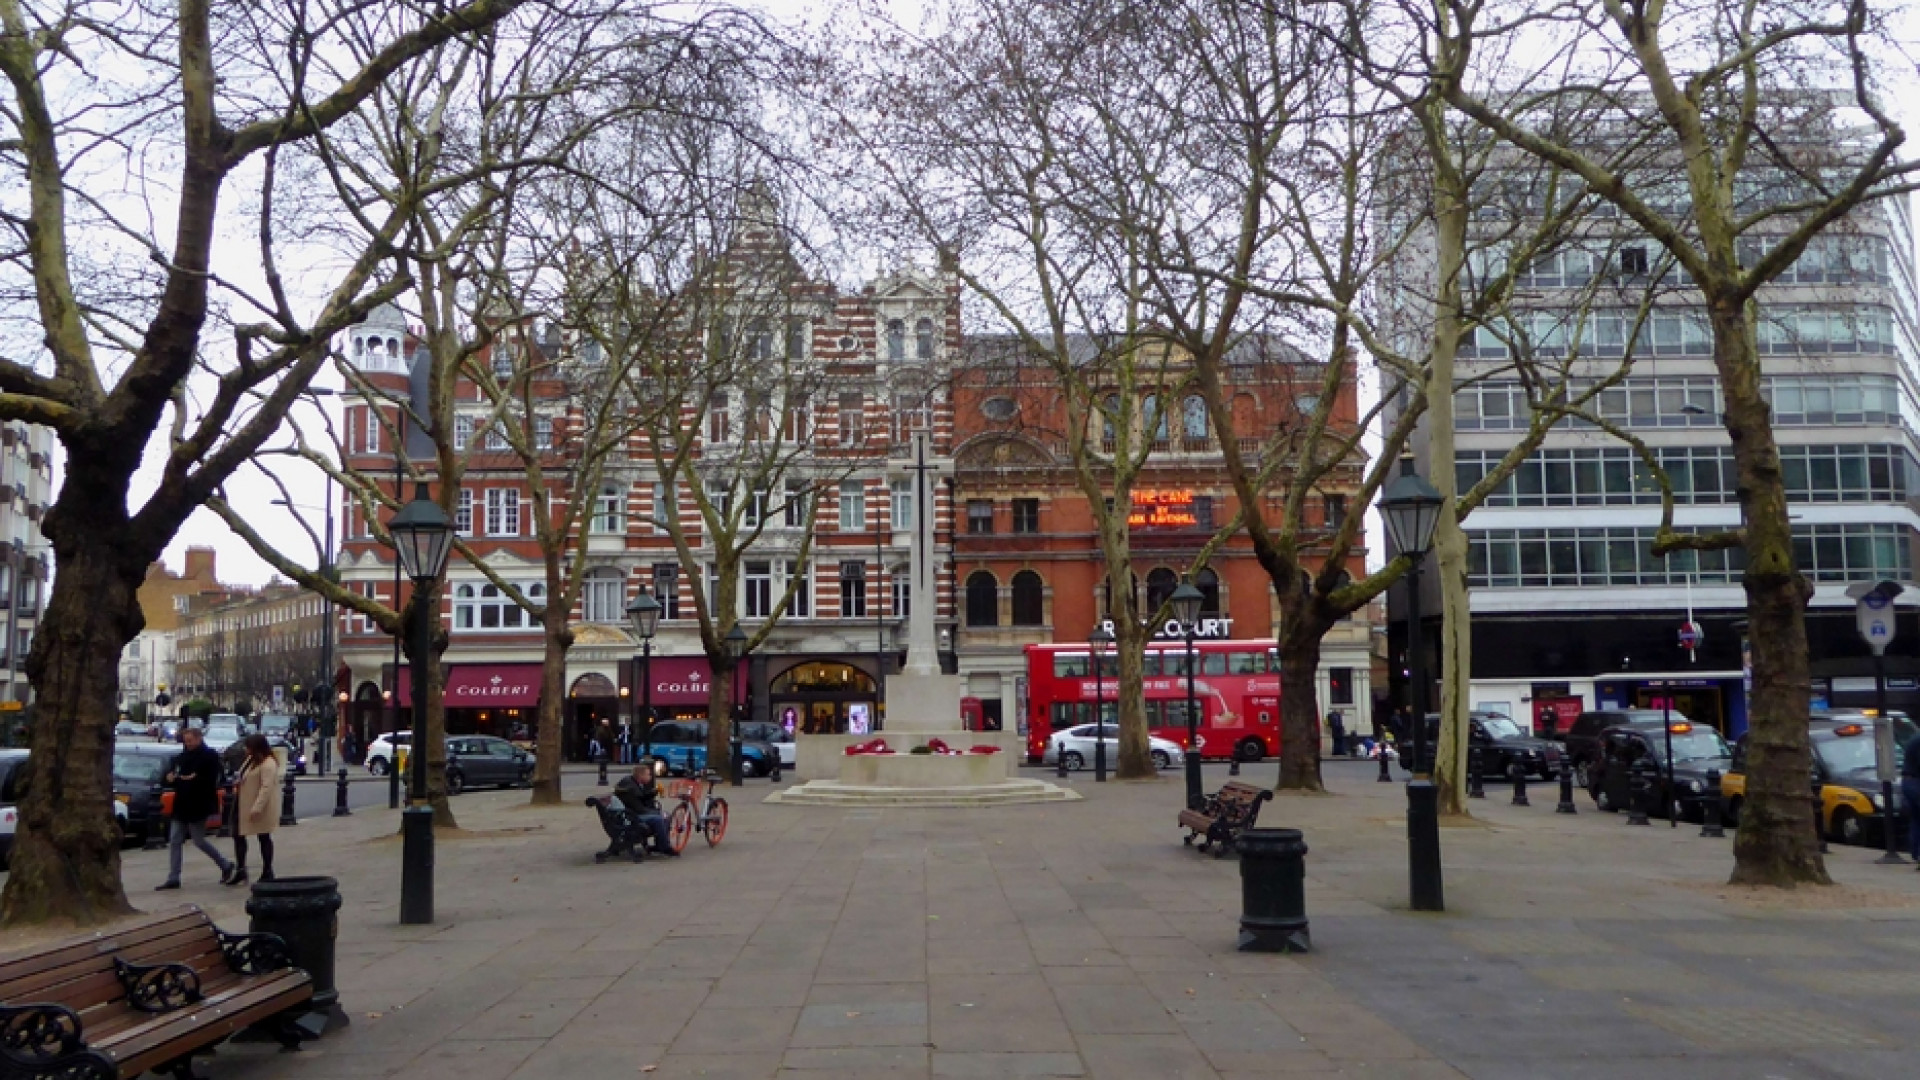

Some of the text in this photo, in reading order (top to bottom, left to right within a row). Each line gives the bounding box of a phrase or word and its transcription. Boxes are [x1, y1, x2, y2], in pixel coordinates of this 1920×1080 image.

[1130, 489, 1156, 503] THE
[456, 685, 529, 696] COLBERT
[657, 682, 710, 693] COLBE
